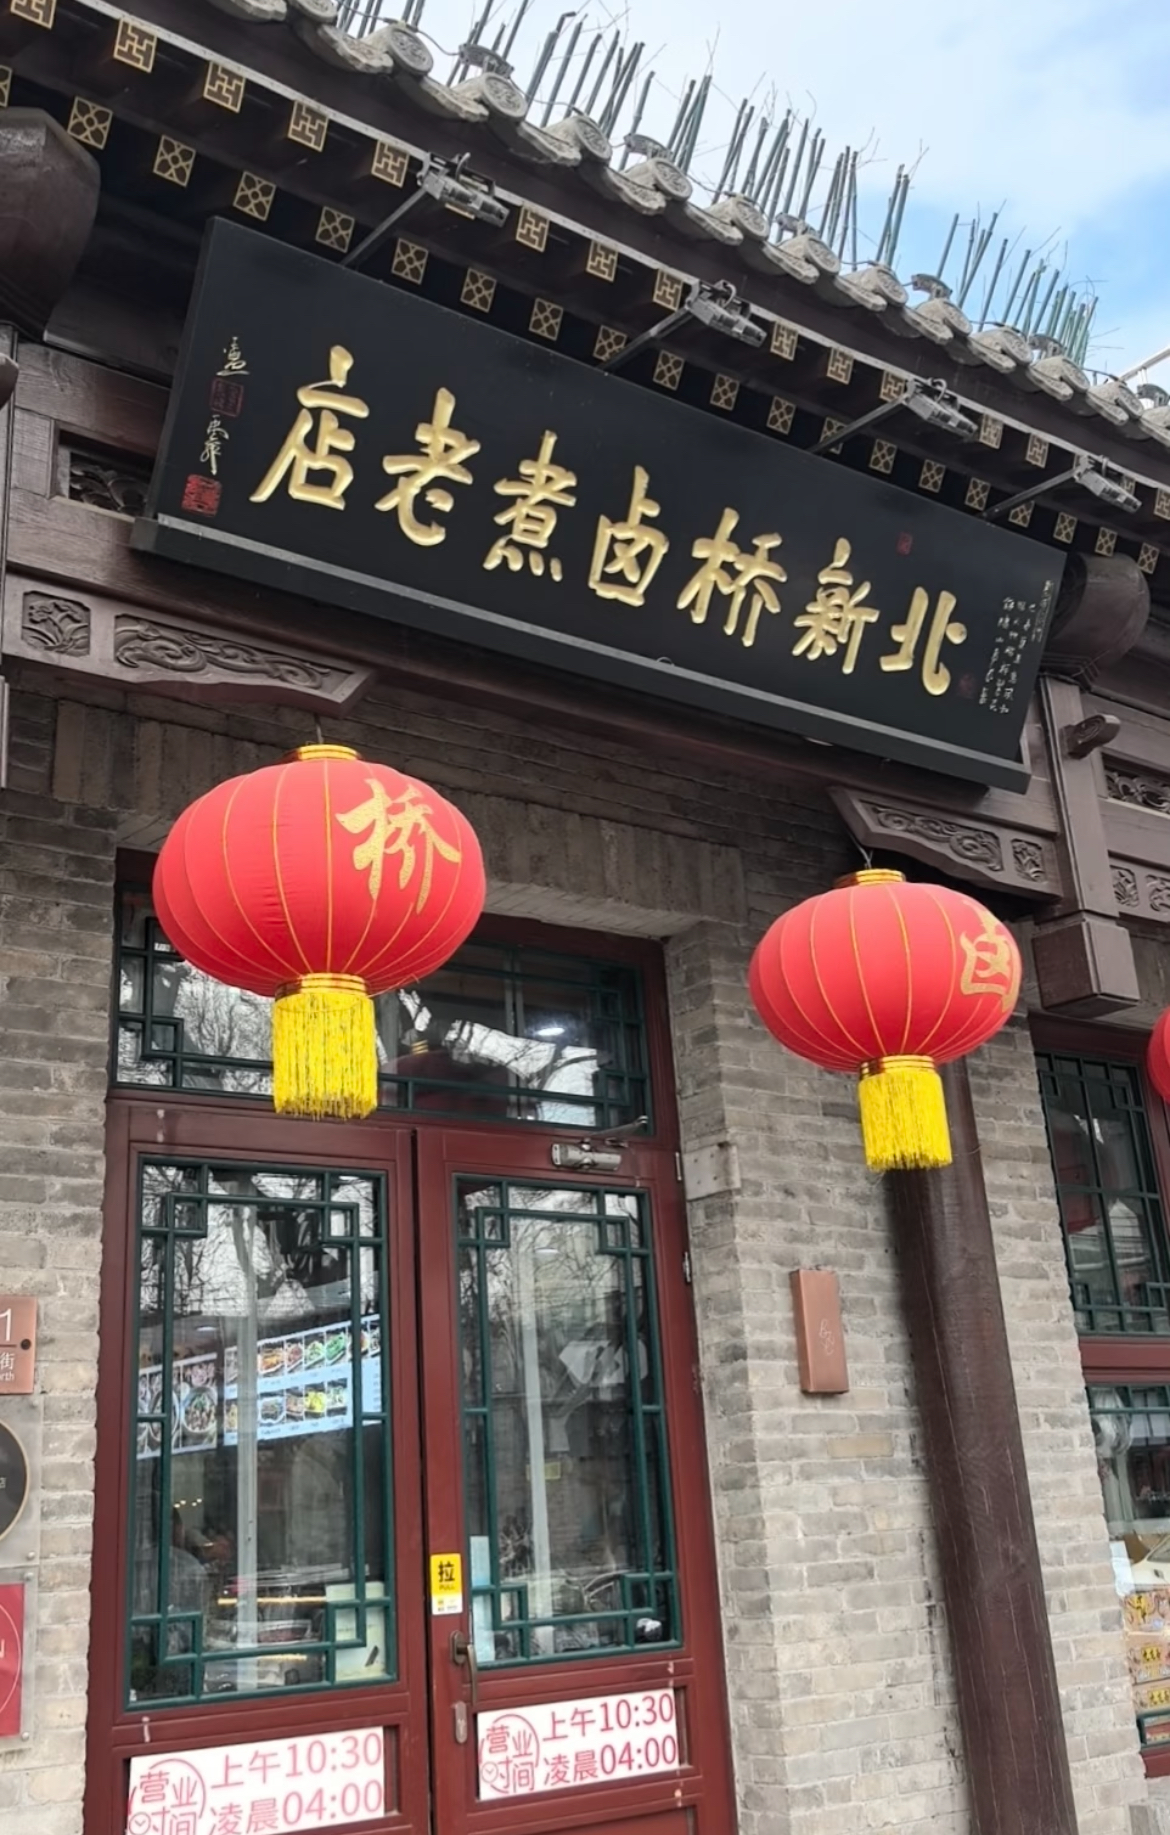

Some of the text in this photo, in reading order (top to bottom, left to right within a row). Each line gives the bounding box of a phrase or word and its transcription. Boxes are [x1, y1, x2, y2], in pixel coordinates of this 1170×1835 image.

[335, 778, 463, 914] 桥
[438, 1560, 456, 1583] 拉
[486, 1724, 533, 1759] 营业
[542, 1693, 675, 1742] 上午10:30
[211, 1732, 382, 1789] 上午10:30
[498, 1756, 535, 1793] 时间
[543, 1734, 677, 1786] 凌晨04:00
[140, 1770, 198, 1809] 营业
[209, 1780, 383, 1835] 凌晨04:00
